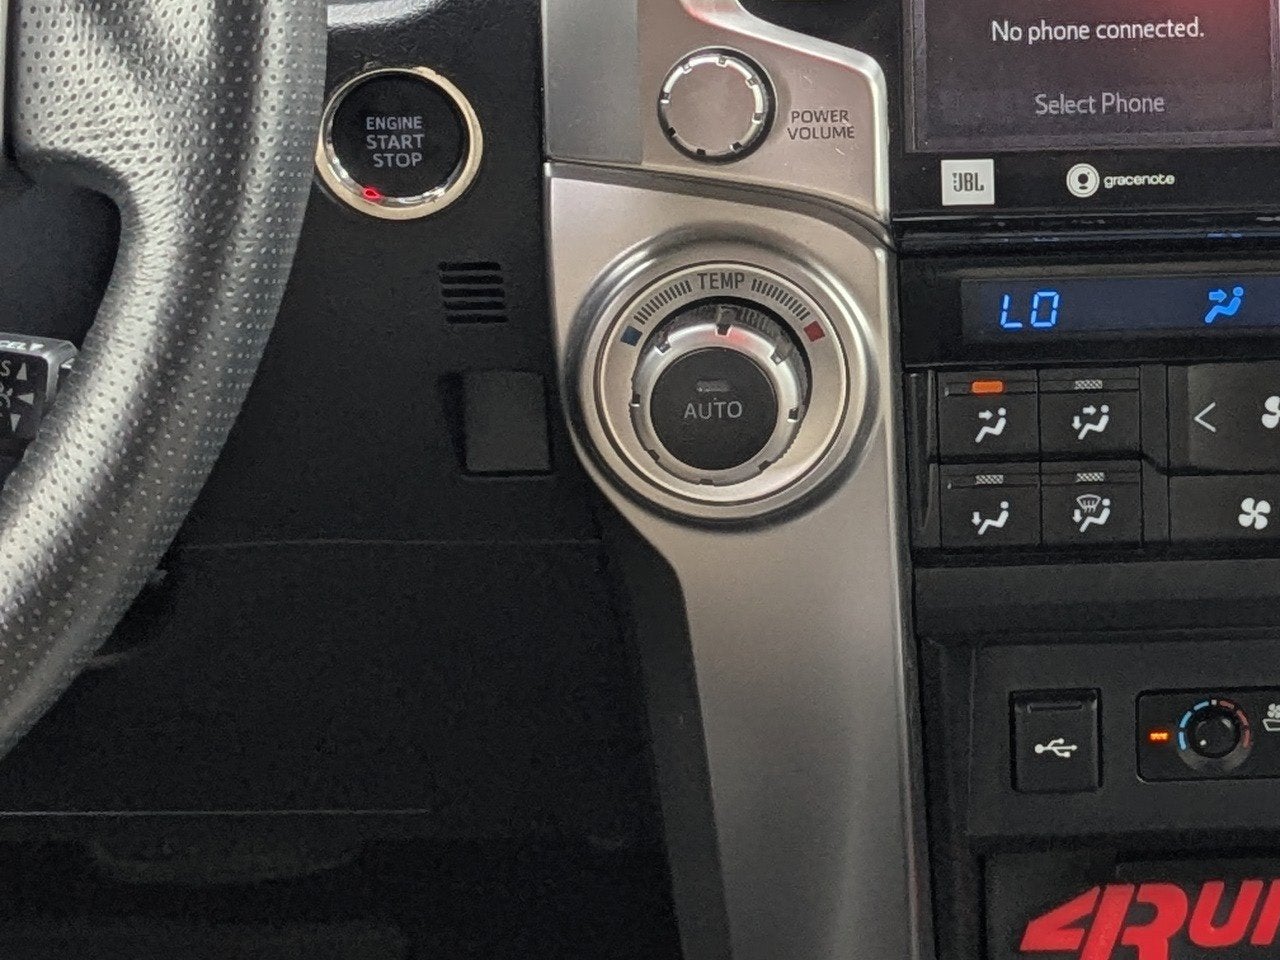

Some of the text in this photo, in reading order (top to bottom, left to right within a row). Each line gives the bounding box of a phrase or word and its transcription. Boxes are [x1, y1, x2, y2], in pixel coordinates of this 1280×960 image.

[991, 16, 1205, 44] No phone connected.
[1034, 91, 1165, 116] Select Phone
[366, 115, 423, 131] ENGINE
[790, 108, 850, 124] POWER
[366, 133, 425, 150] START
[787, 125, 856, 141] VOLUME
[372, 152, 423, 168] STOP
[952, 172, 985, 193] JBL
[1103, 172, 1176, 189] gracenote
[696, 271, 747, 291] TEMP
[683, 400, 743, 420] AUTO
